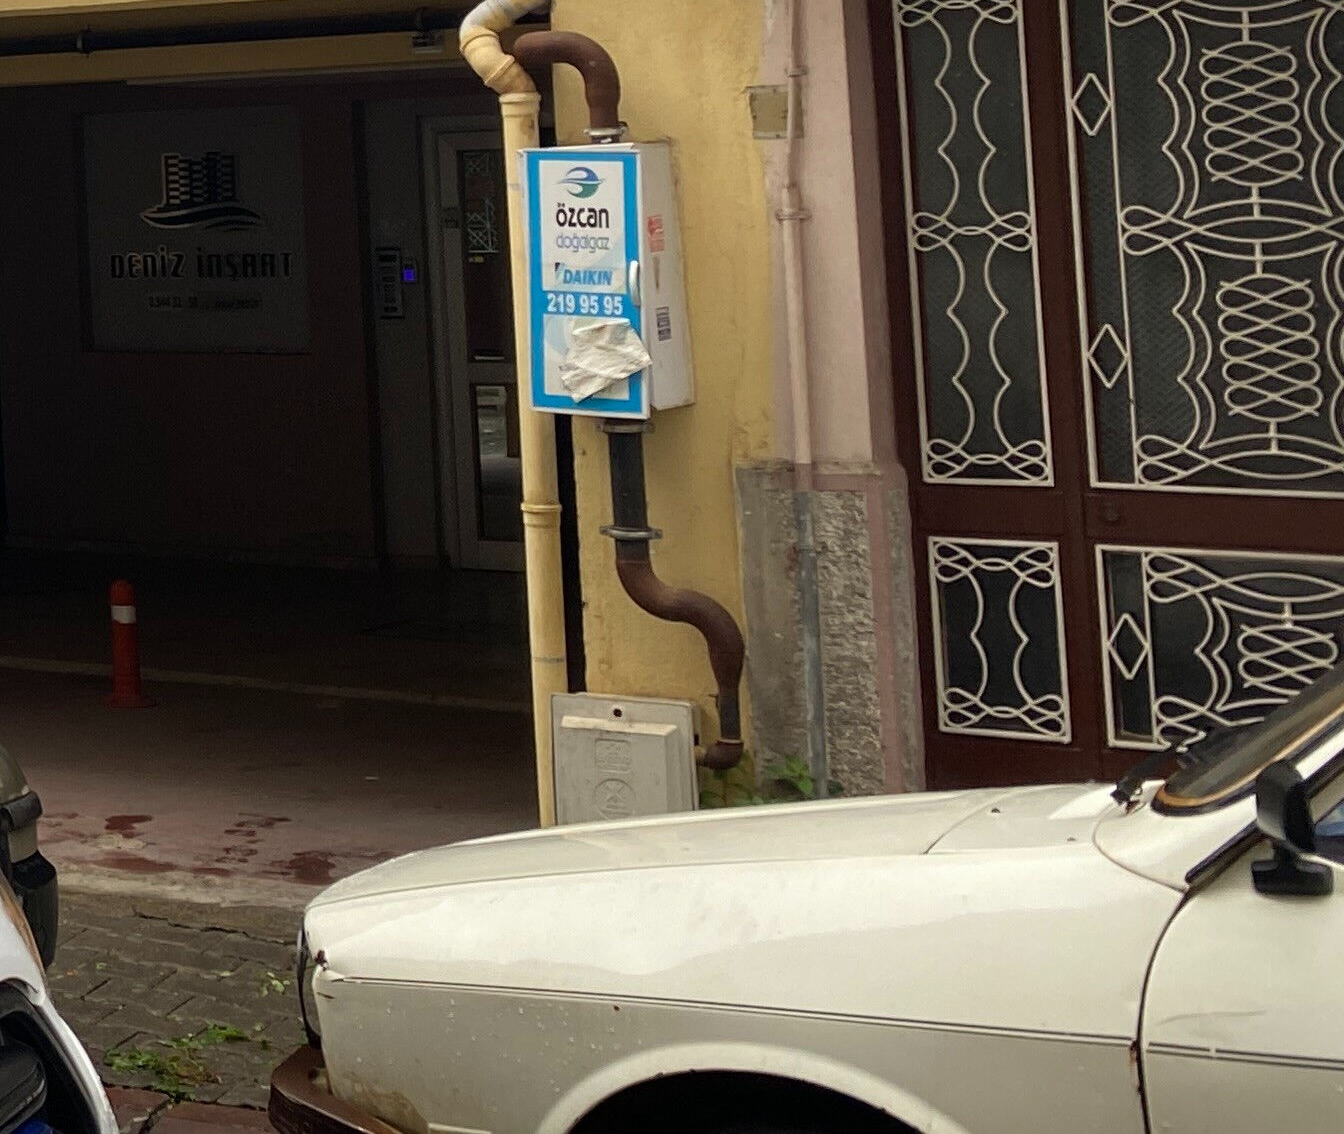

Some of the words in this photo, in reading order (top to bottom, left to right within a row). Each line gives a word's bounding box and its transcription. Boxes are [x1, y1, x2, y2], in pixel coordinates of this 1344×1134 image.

[556, 203, 609, 228] özcan
[563, 269, 613, 286] DAIKIN
[547, 293, 575, 314] 219
[580, 294, 599, 315] 95
[603, 296, 623, 316] 95
